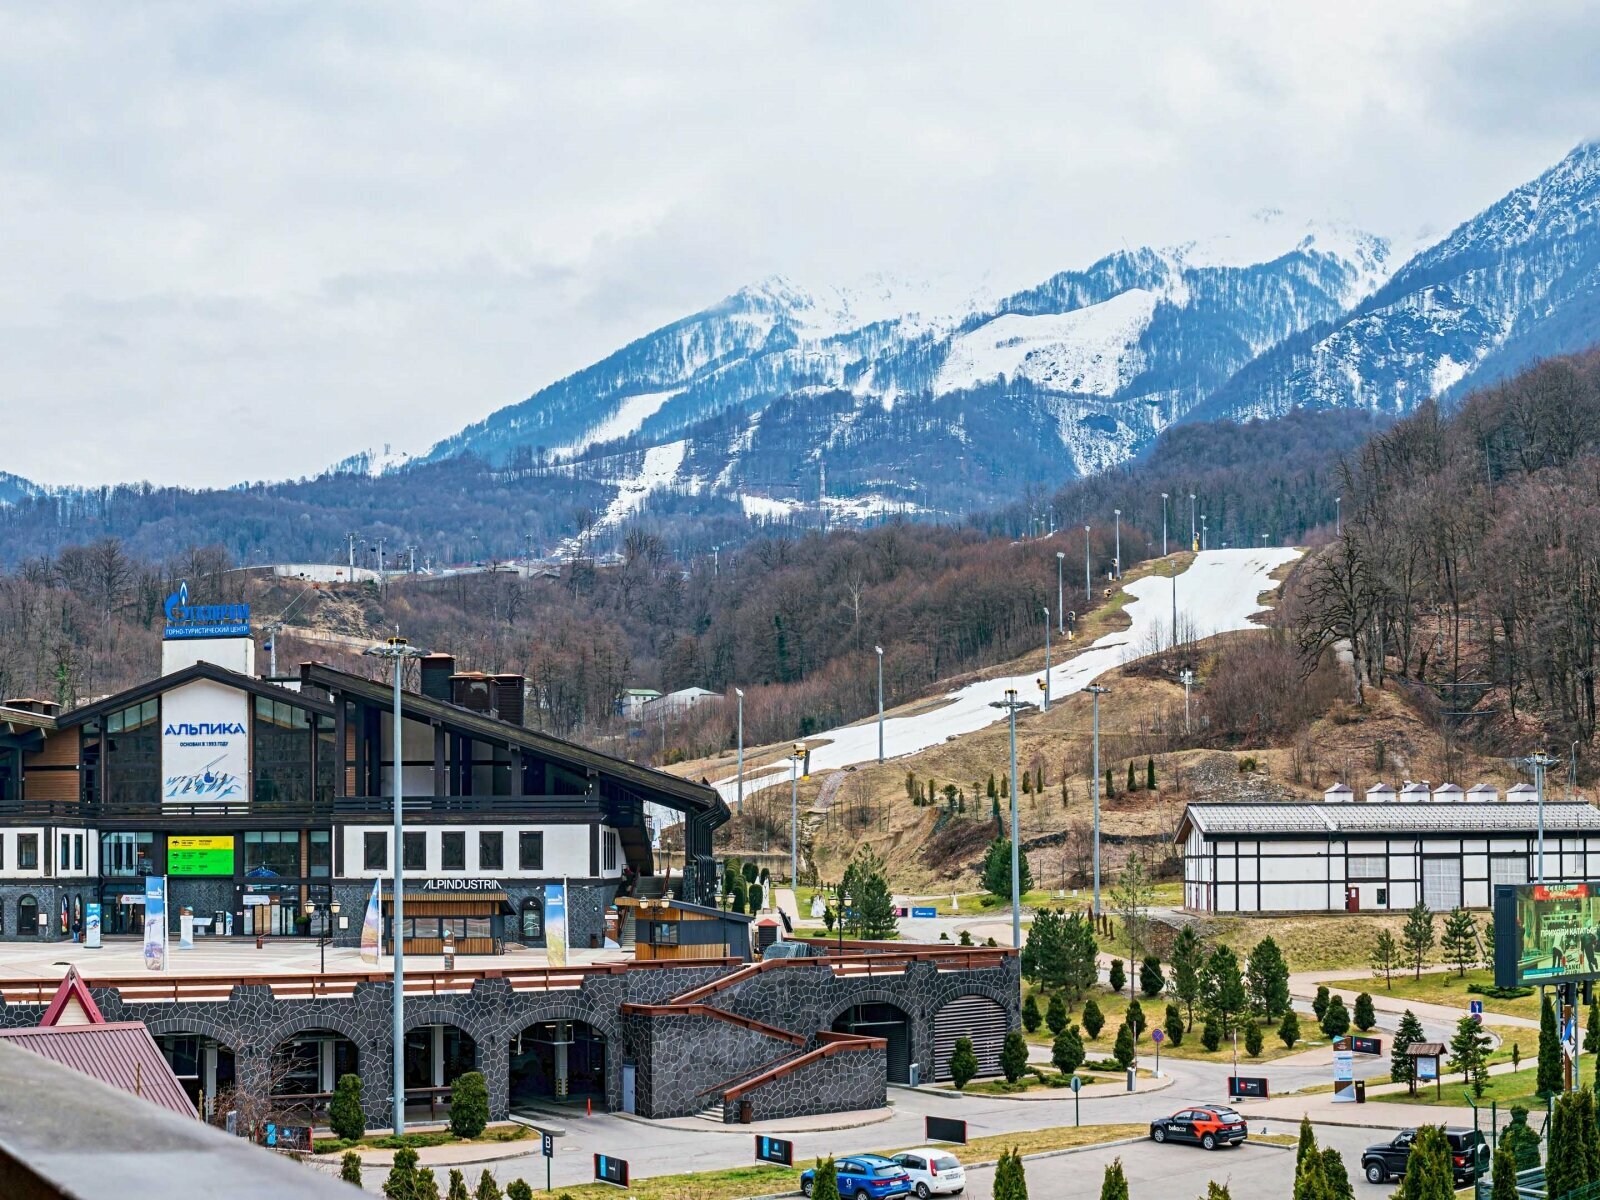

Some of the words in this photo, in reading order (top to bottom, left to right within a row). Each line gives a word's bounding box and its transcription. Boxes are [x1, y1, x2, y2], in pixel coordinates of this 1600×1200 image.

[166, 626, 229, 635] ГОРНО-ТУРИСТИЧЕСКИЙ
[231, 625, 248, 633] ЦЕНТР
[164, 722, 246, 736] АЛЬПИКА
[423, 879, 503, 890] ALPINDUSTRIA
